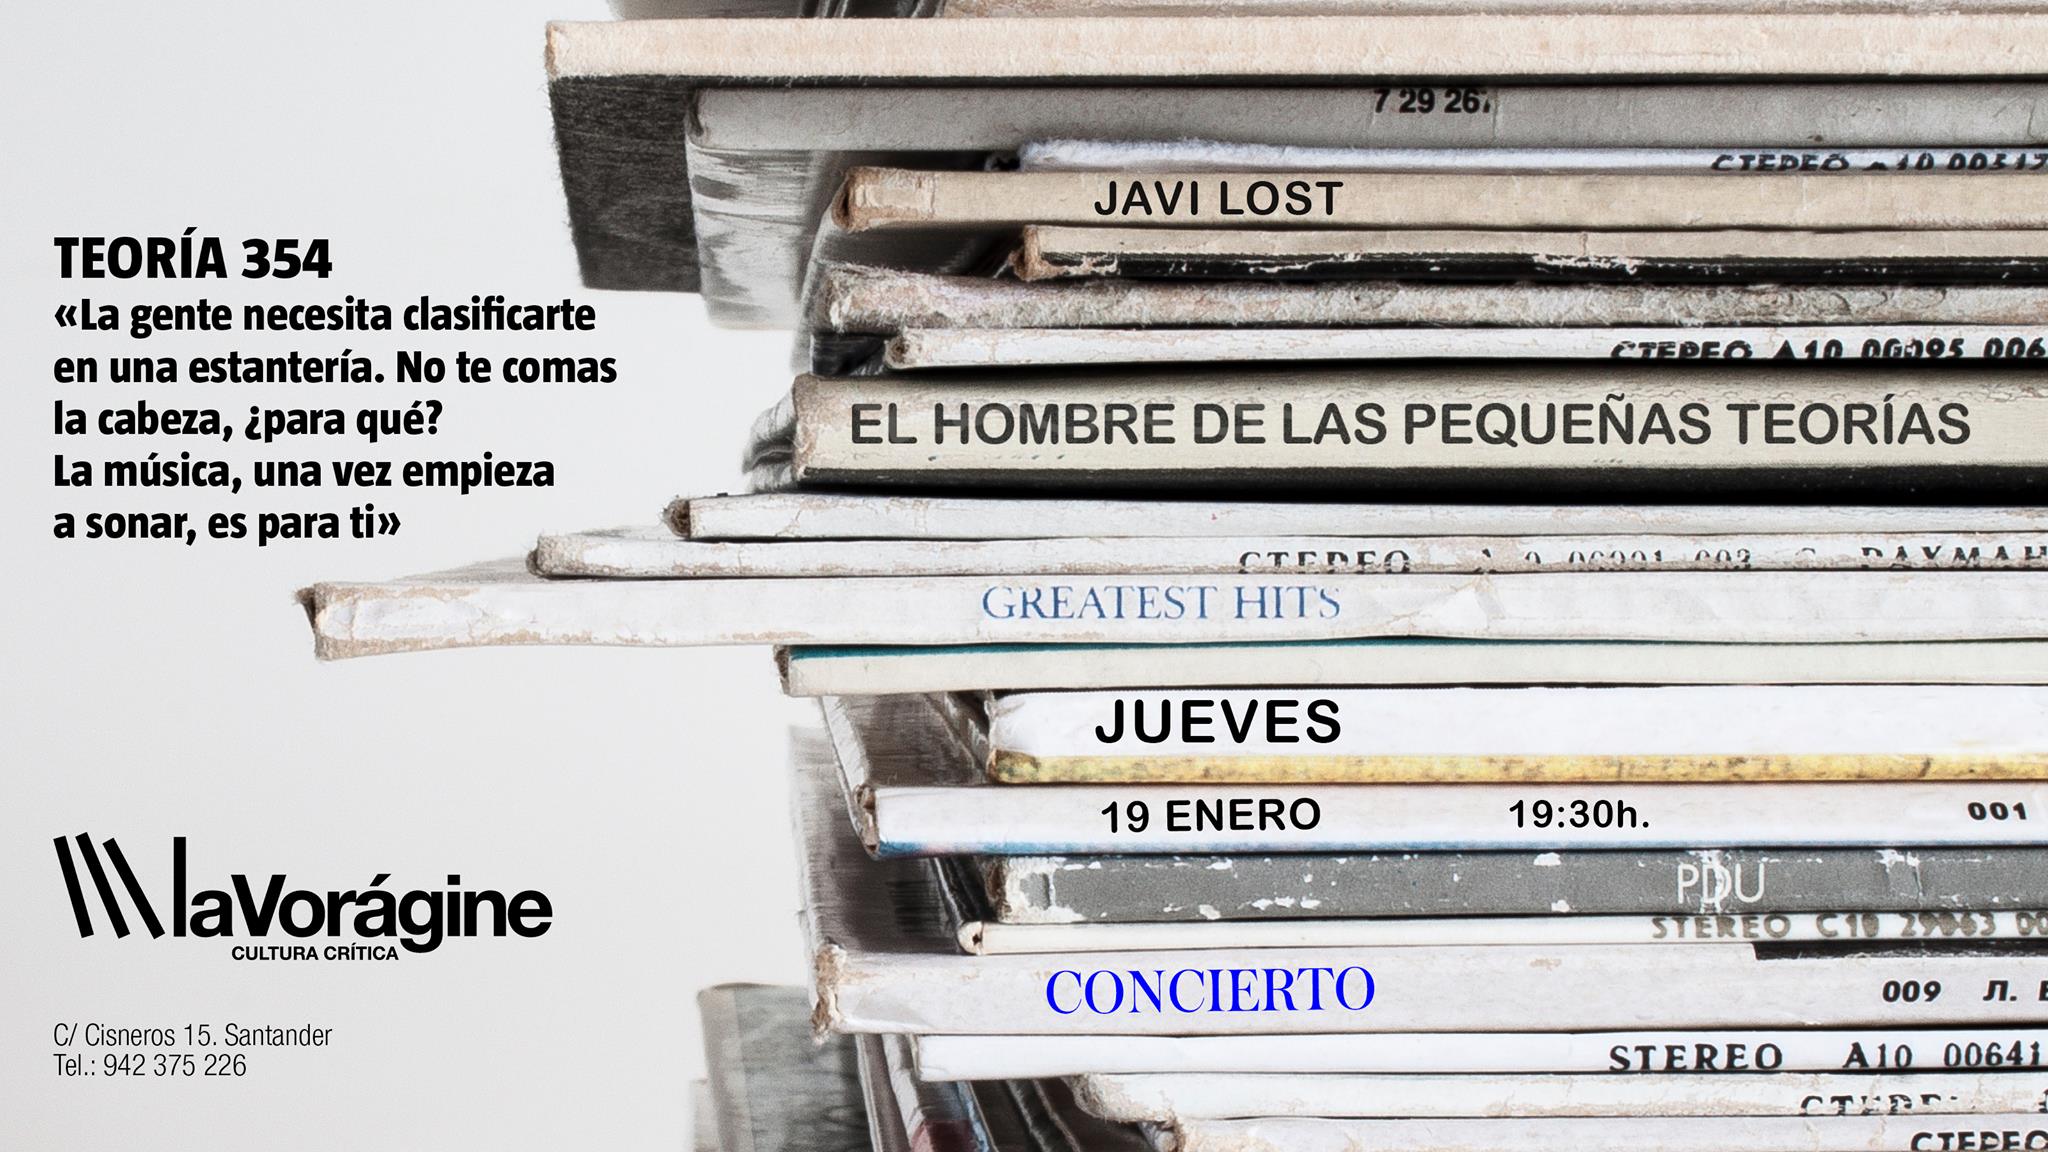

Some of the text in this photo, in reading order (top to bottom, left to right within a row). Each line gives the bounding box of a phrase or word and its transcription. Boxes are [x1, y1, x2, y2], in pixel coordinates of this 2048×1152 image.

[1373, 88, 1392, 113] 7
[1398, 88, 1436, 113] 29
[982, 586, 1341, 619] GREATEST HITS
[1968, 803, 2026, 820] 001
[1677, 862, 1765, 904] PDU
[1652, 916, 1791, 938] STEREO
[1883, 981, 1941, 1002] 009
[1609, 1043, 1783, 1071] STEREO
[1943, 1041, 2041, 1068] 00641
